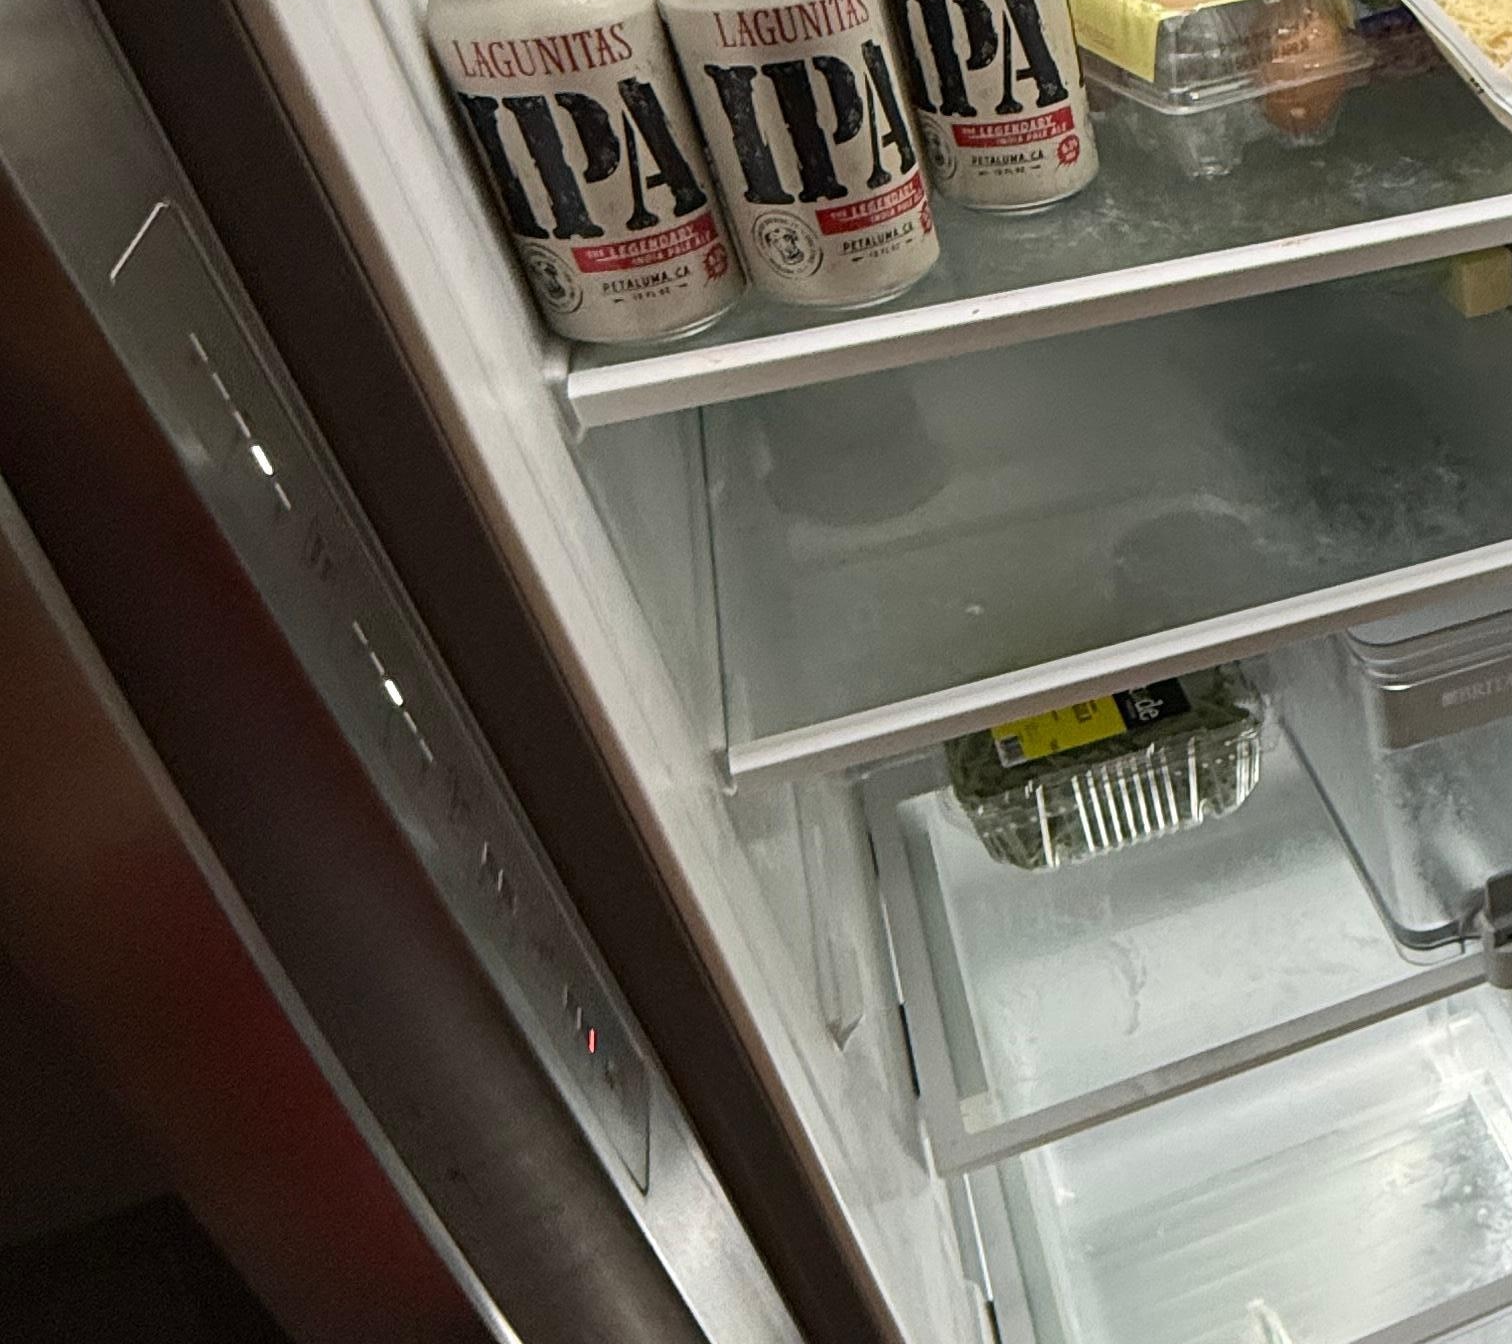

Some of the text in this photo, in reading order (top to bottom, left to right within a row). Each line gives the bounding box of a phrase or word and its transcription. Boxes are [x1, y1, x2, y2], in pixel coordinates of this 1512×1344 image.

[453, 21, 633, 80] LAGUNITAS
[703, 38, 919, 205] IPA
[978, 115, 1053, 138] LEGENDARY
[457, 76, 708, 240] IPA
[1029, 149, 1044, 161] CA
[610, 225, 697, 258] LEGENDARY
[672, 264, 691, 279] CA
